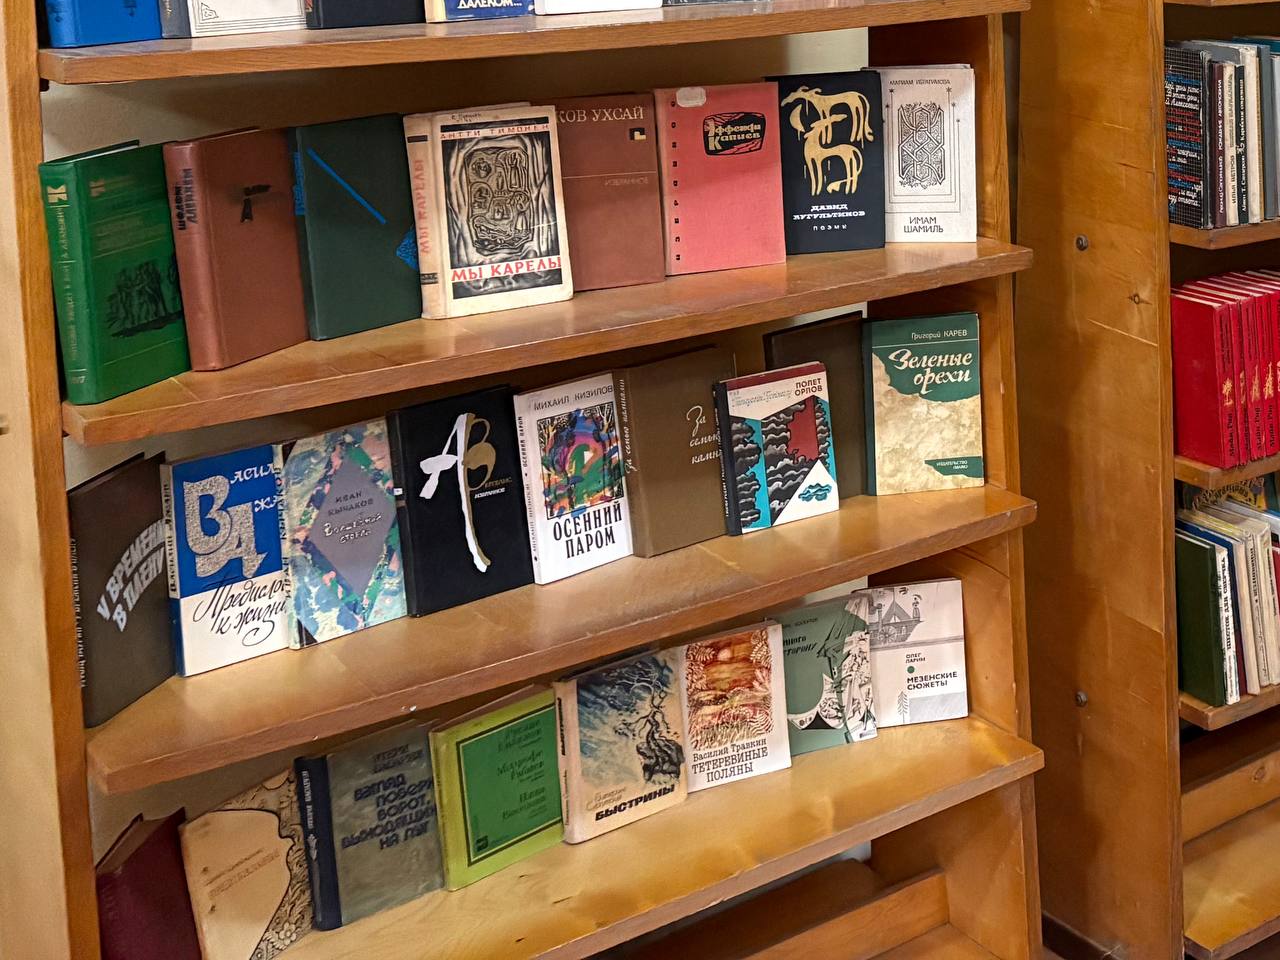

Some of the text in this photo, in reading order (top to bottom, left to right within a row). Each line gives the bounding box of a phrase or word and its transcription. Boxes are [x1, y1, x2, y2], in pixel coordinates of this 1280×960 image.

[592, 106, 644, 122] УХСАЙ
[903, 224, 944, 234] ШАМИЛЬ
[909, 216, 938, 225] ИМАМ
[451, 254, 562, 282] МЫ КАРЕЛЫ
[943, 329, 968, 338] КАРЕВ
[888, 348, 973, 371] Зеленые
[794, 385, 823, 397] ОРЛОВ
[795, 377, 822, 389] ПОЛЕТ
[913, 366, 972, 395] орехи
[533, 384, 613, 411] МИХАИЛ КИЗИЛОВ
[686, 405, 707, 437] За
[552, 501, 623, 541] ОСЕННИЙ
[565, 526, 616, 560] ПАРОМ
[906, 671, 958, 684] МЕЗЕНСКИЕ
[906, 680, 948, 691] СЮЖЕТЫ
[691, 746, 769, 775] ТЕТЕРЕВИНЫЕ
[692, 739, 768, 763] Василий Травкин
[706, 762, 755, 783] ПОЛЯНЫ
[595, 784, 675, 822] БЫСТРИНЫ
